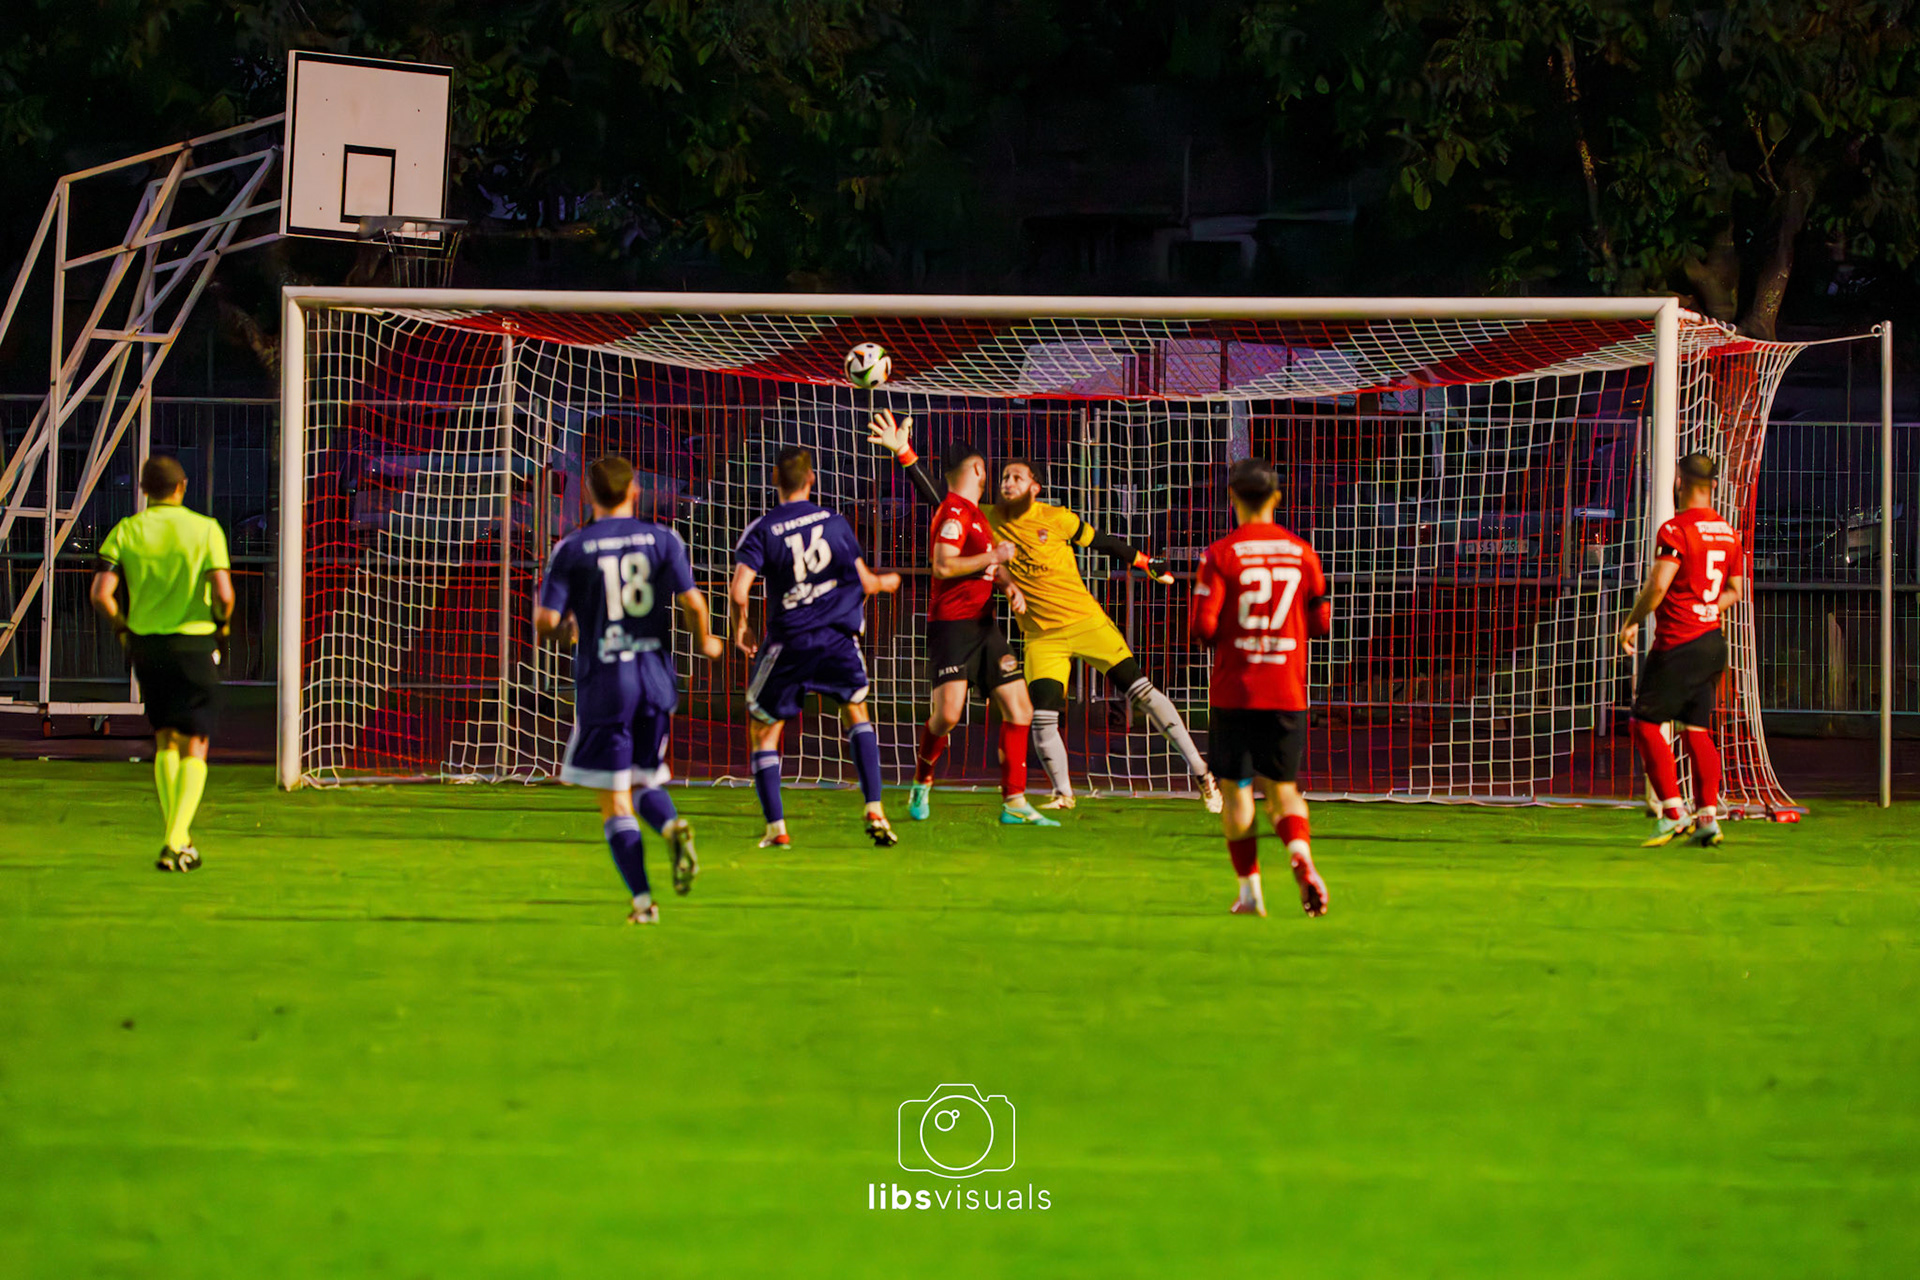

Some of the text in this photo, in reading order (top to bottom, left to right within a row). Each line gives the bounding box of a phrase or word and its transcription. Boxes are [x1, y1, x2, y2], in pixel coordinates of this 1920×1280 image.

[784, 524, 832, 583] 16
[1703, 550, 1726, 603] 5
[597, 552, 654, 622] 18
[1238, 567, 1302, 631] 27
